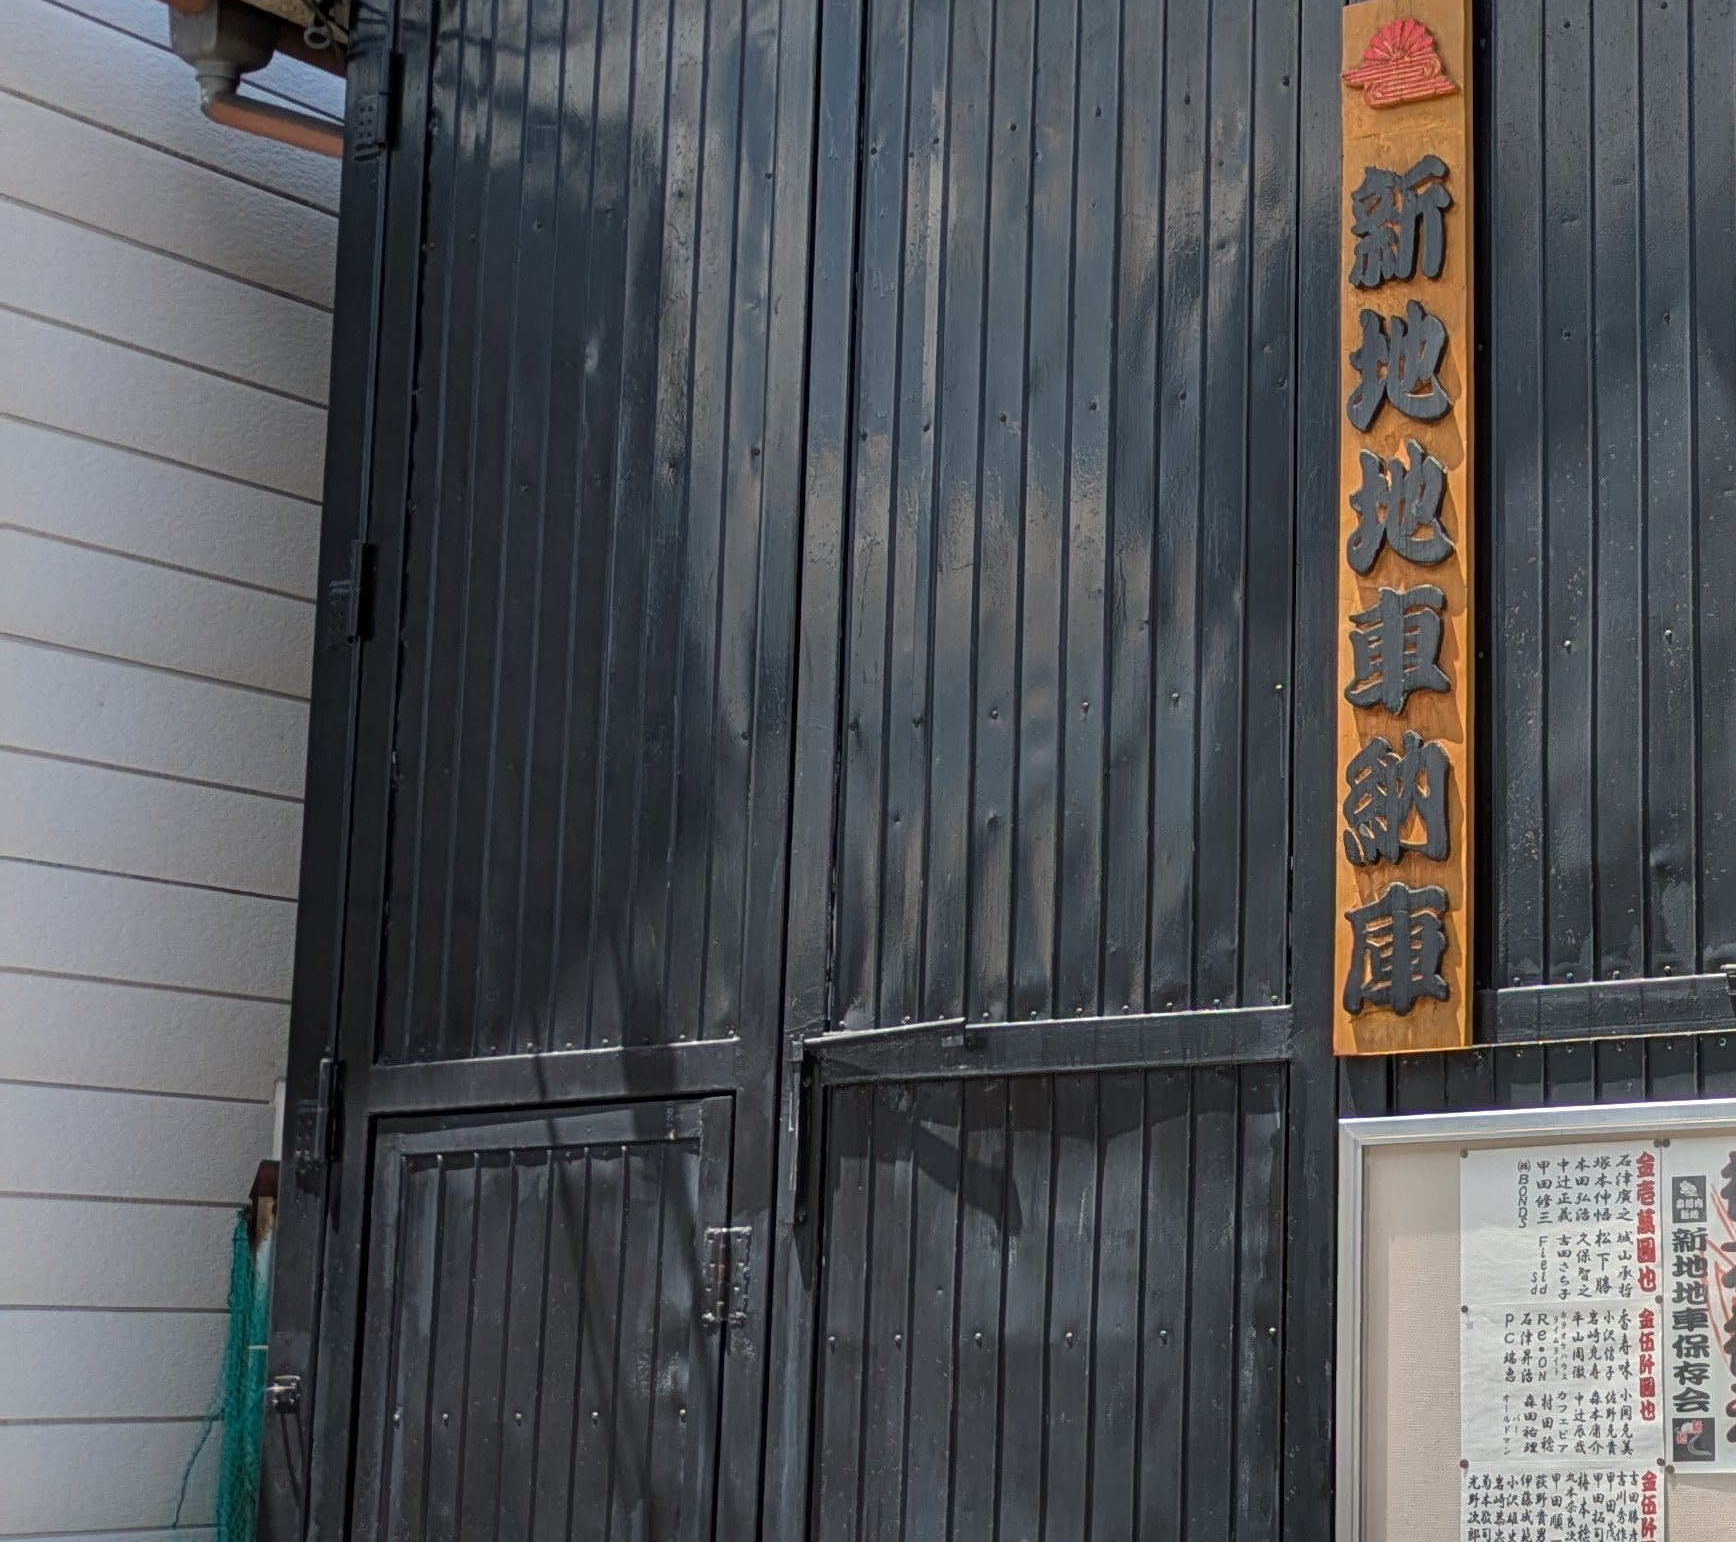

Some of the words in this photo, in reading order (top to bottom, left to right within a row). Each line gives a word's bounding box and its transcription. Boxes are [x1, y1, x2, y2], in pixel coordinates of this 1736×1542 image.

[1348, 155, 1454, 1017] 新地地車納庫
[1535, 1160, 1553, 1224] 甲田修三
[1556, 1158, 1573, 1223] 中辻正義
[1574, 1157, 1591, 1221] 本田弘治
[1615, 1154, 1634, 1222] 石津廣之
[1557, 1235, 1572, 1300] 吉田さち子
[1577, 1232, 1593, 1298] 久保智之
[1595, 1229, 1612, 1294] 松下勝
[1603, 1310, 1616, 1380] 小沢信子
[1672, 1227, 1711, 1413] 新地地車保存会
